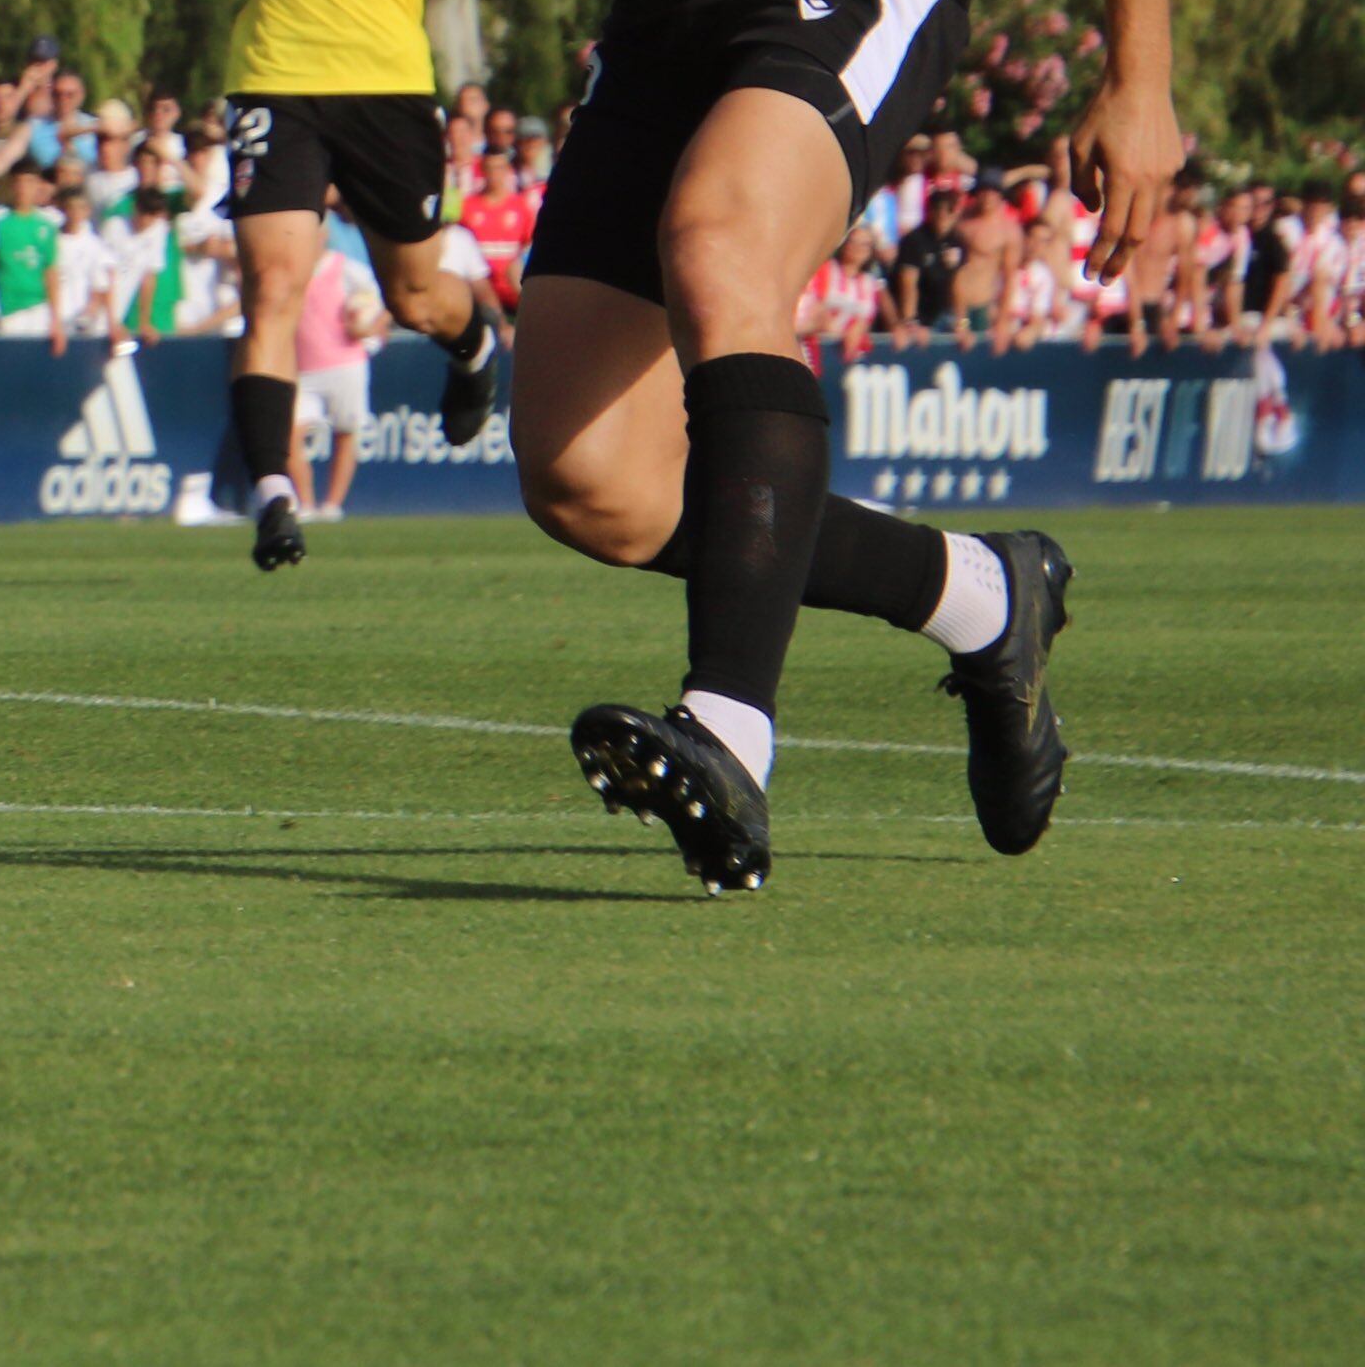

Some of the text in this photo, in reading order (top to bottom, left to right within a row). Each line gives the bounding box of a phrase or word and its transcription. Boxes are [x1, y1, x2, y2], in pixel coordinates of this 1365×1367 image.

[844, 360, 1051, 461] Mahou
[1092, 377, 1171, 483] BEST
[39, 453, 173, 515] adidas
